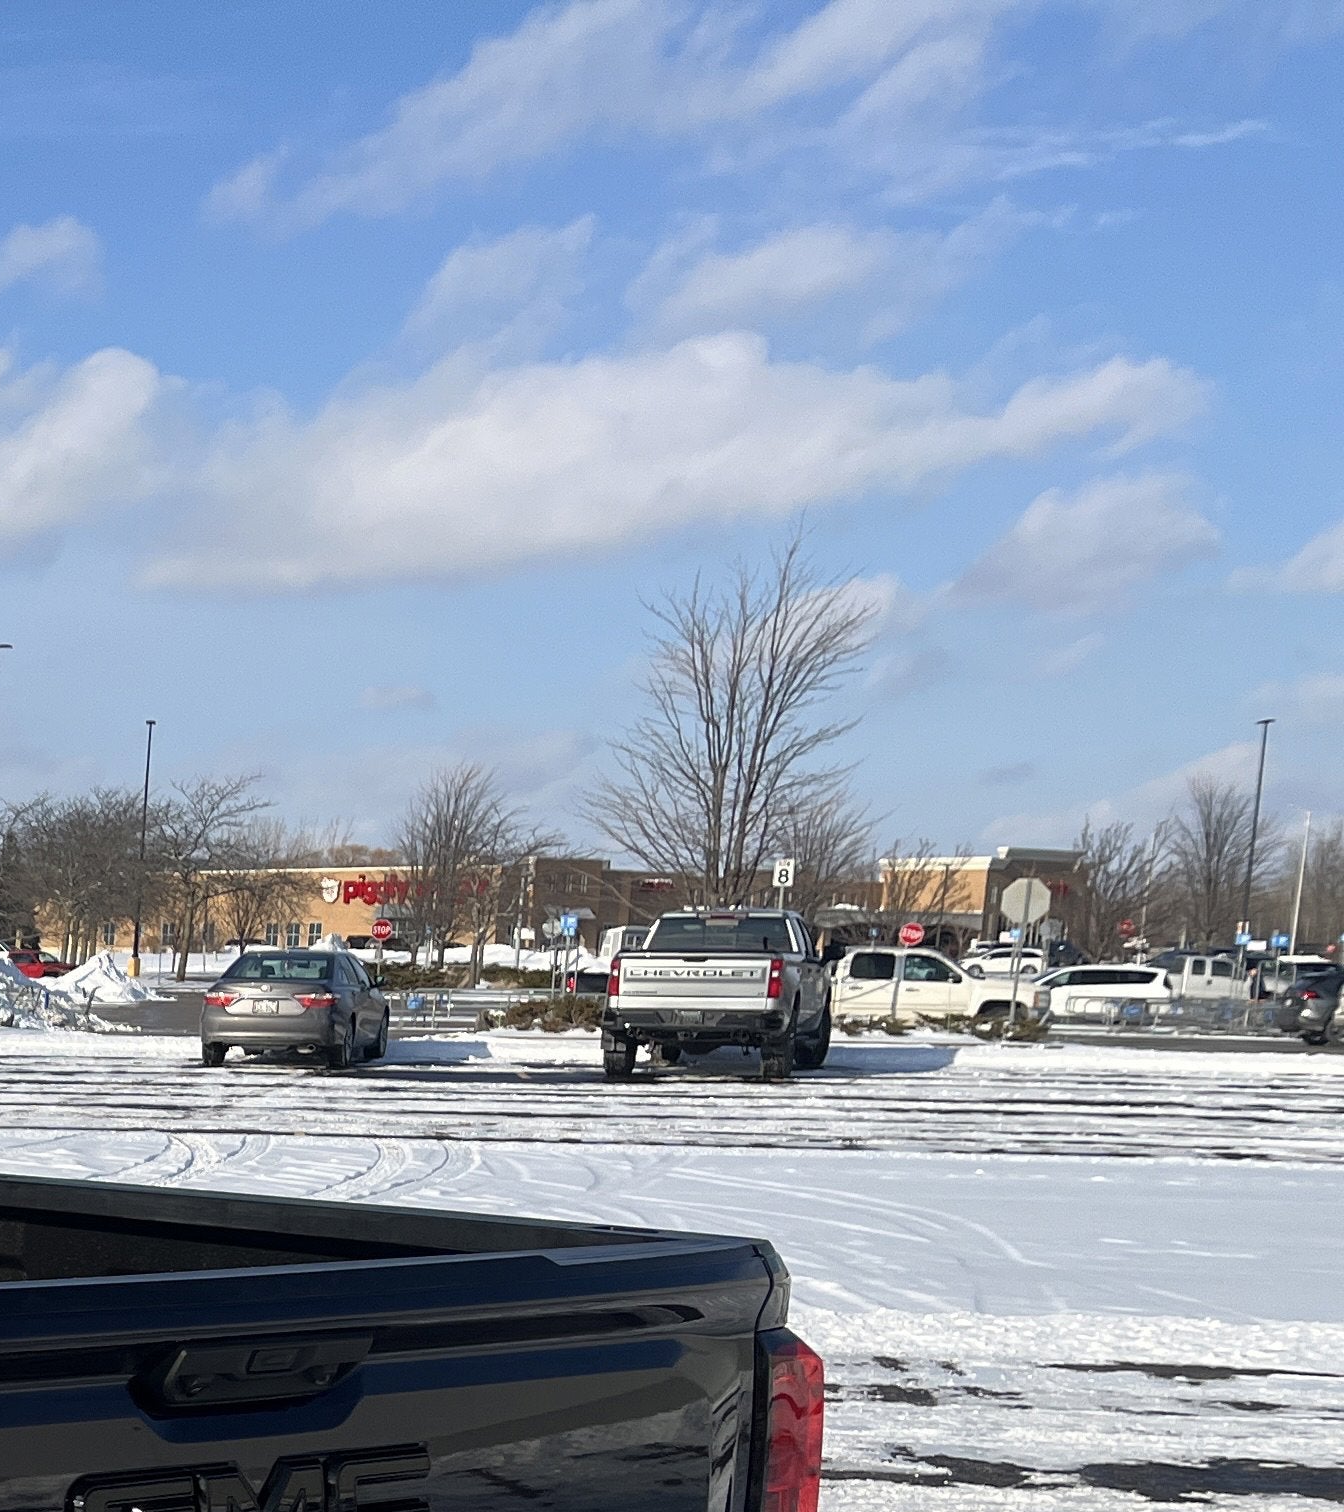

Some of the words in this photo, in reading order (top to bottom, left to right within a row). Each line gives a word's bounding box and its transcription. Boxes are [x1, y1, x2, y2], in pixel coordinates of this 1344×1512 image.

[778, 868, 789, 884] 8
[372, 925, 392, 935] STOP
[629, 969, 758, 977] CHEVROLET
